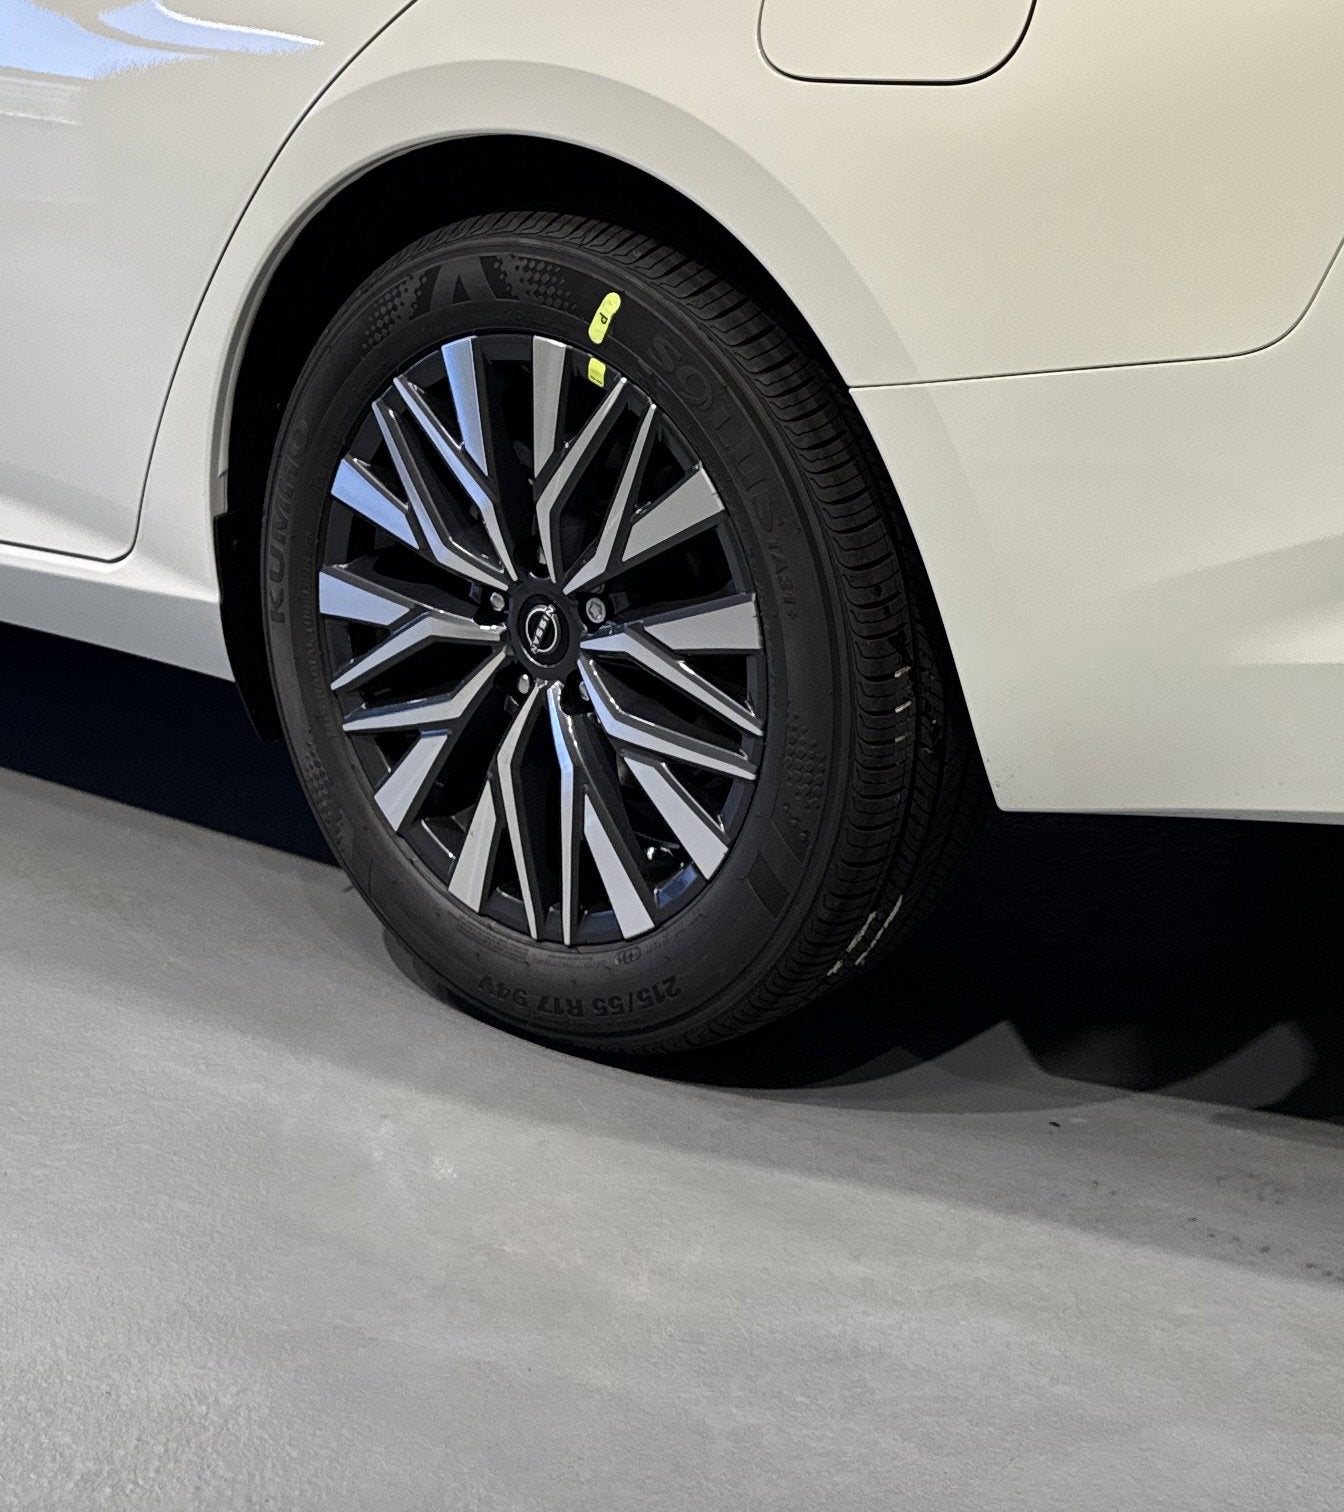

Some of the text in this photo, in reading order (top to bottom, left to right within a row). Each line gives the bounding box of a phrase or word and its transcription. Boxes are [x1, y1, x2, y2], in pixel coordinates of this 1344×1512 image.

[268, 419, 309, 625] KUMHO
[530, 604, 555, 655] NISSAN
[477, 973, 682, 1018] 215/55 R17 94V
